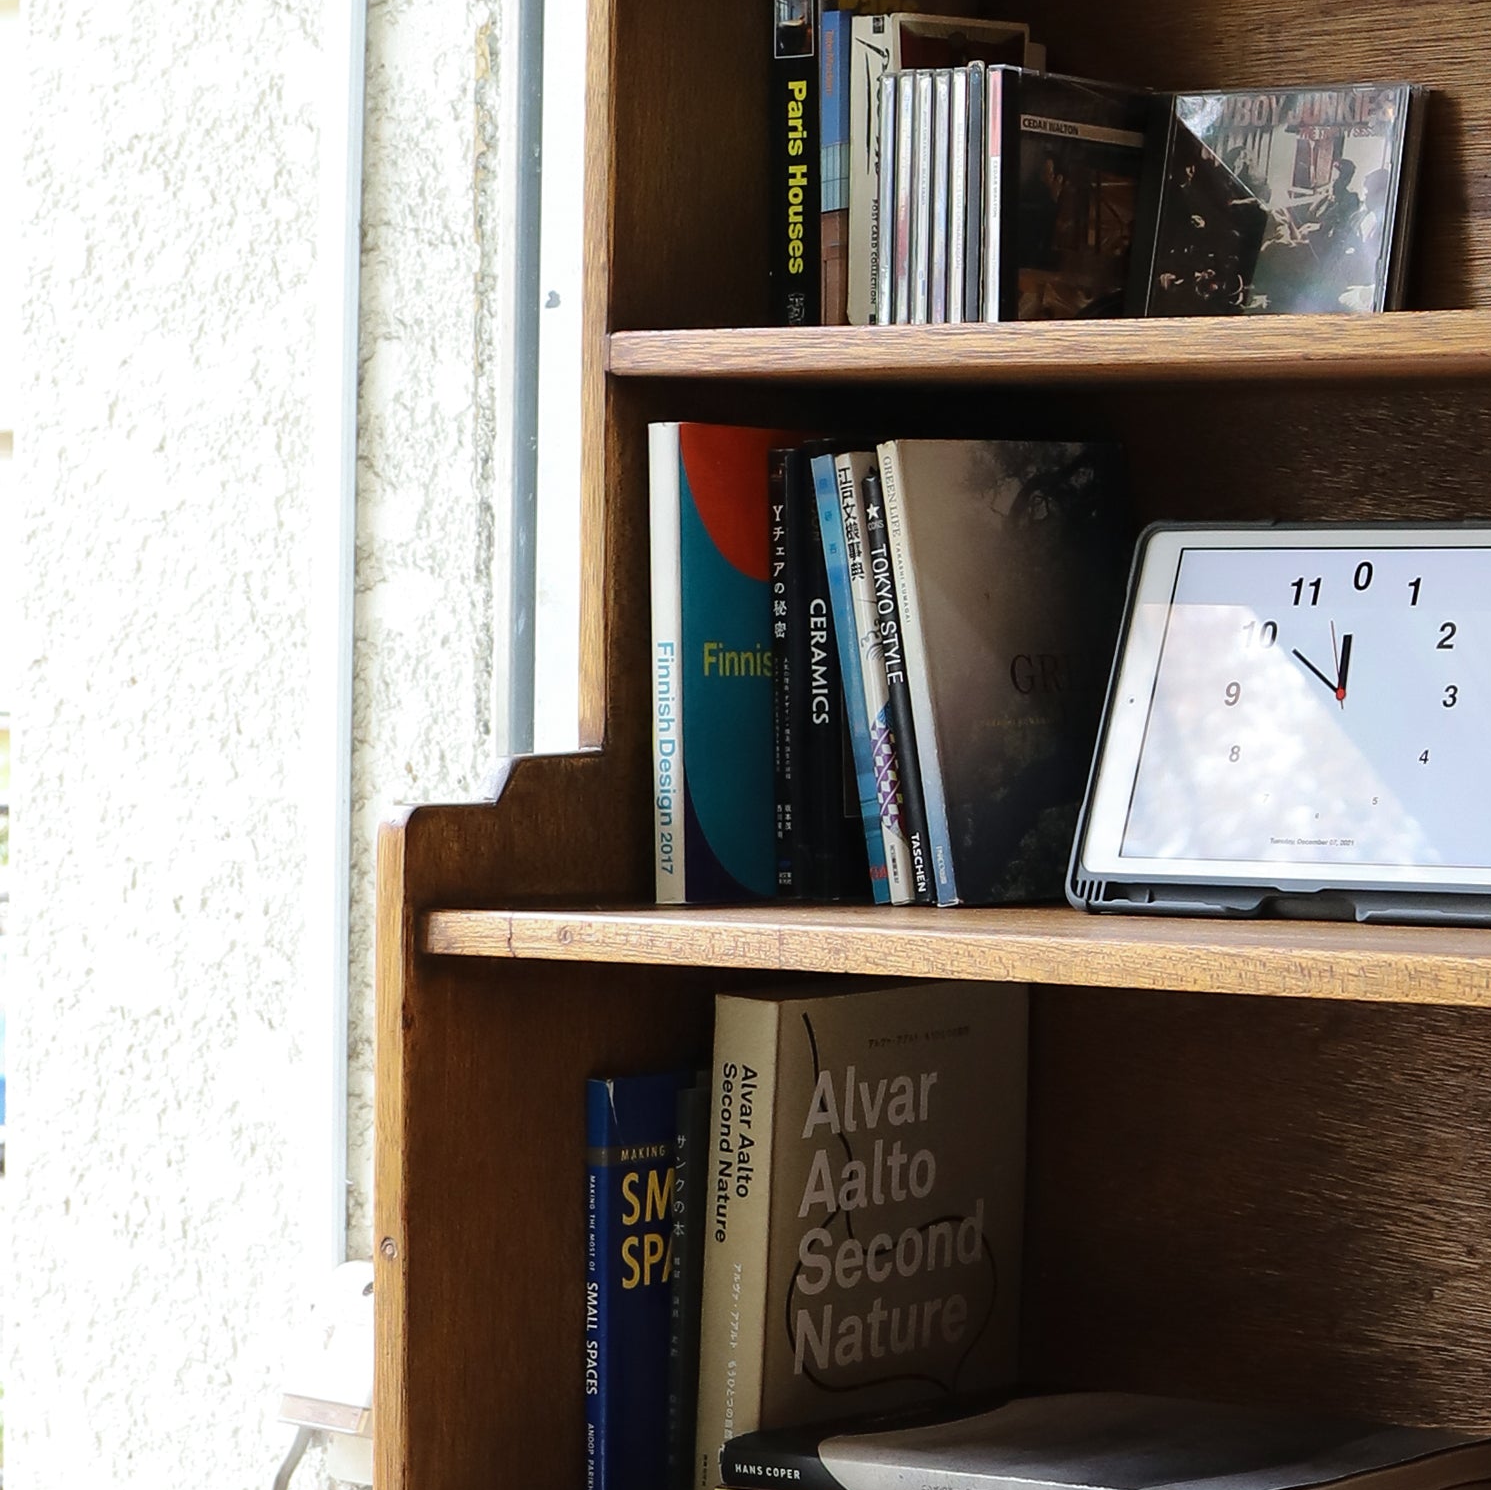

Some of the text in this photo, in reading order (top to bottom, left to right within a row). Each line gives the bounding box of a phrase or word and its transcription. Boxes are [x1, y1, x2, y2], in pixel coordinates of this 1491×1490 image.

[1022, 117, 1048, 131] CEDAR
[787, 80, 808, 275] Paris Houses
[871, 198, 880, 219] POST
[870, 251, 878, 305] COLLECTION
[883, 455, 897, 503] GREEN
[889, 505, 901, 538] LIFE
[772, 504, 788, 640] Yチェアの秘密
[1353, 561, 1374, 591] 0
[1291, 577, 1322, 606] 11
[1408, 577, 1422, 606] 1
[871, 543, 904, 686] TOKYO STYLE
[1242, 620, 1279, 649] 10
[1436, 621, 1457, 650] 2
[809, 597, 829, 726] CERAMICS
[1224, 681, 1241, 707] 9
[1442, 684, 1459, 708] 3
[657, 641, 677, 876] Finnish Design 2017
[1229, 745, 1241, 763] 8
[1418, 749, 1430, 765] 4
[1371, 796, 1379, 805] 5
[1297, 837, 1328, 846] December
[910, 832, 927, 893] TASCHEN
[801, 1064, 938, 1141] Alvar
[735, 1064, 758, 1199] Alvar Aalto
[620, 1145, 666, 1162] MAKING
[715, 1062, 738, 1244] Second Nature
[588, 1174, 596, 1211] MAKING
[673, 1133, 687, 1237] サンクの本
[797, 1138, 937, 1220] Aalto
[795, 1197, 985, 1297] Second
[588, 1261, 594, 1272] OF
[586, 1281, 599, 1331] SMALL
[793, 1292, 969, 1376] Nature
[585, 1339, 598, 1396] SPACES
[586, 1423, 594, 1455] ANOOP
[734, 1462, 801, 1481] HANS COPER
